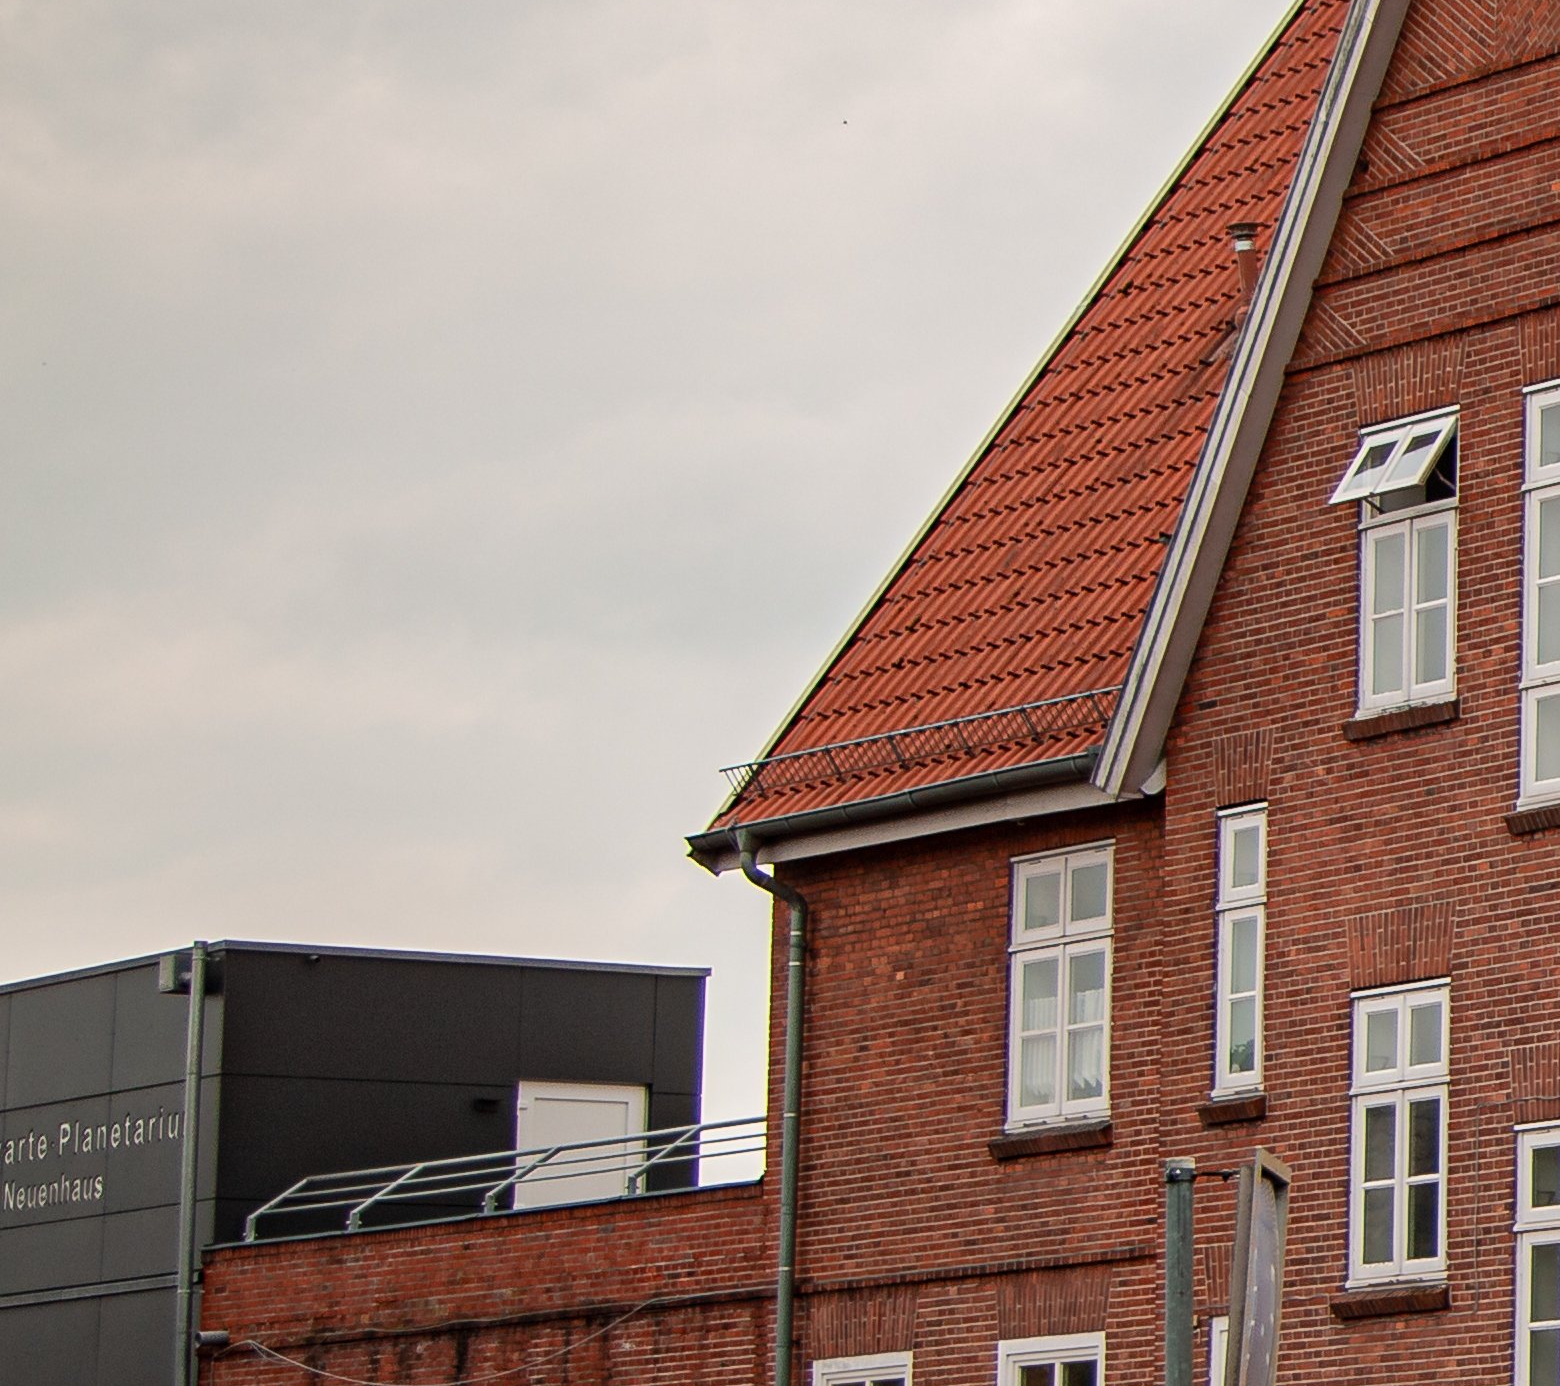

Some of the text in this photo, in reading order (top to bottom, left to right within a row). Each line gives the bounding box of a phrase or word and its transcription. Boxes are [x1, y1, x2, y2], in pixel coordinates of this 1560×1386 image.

[0, 1106, 187, 1164] arte Planetariu
[3, 1173, 104, 1211] Neuenhaus
